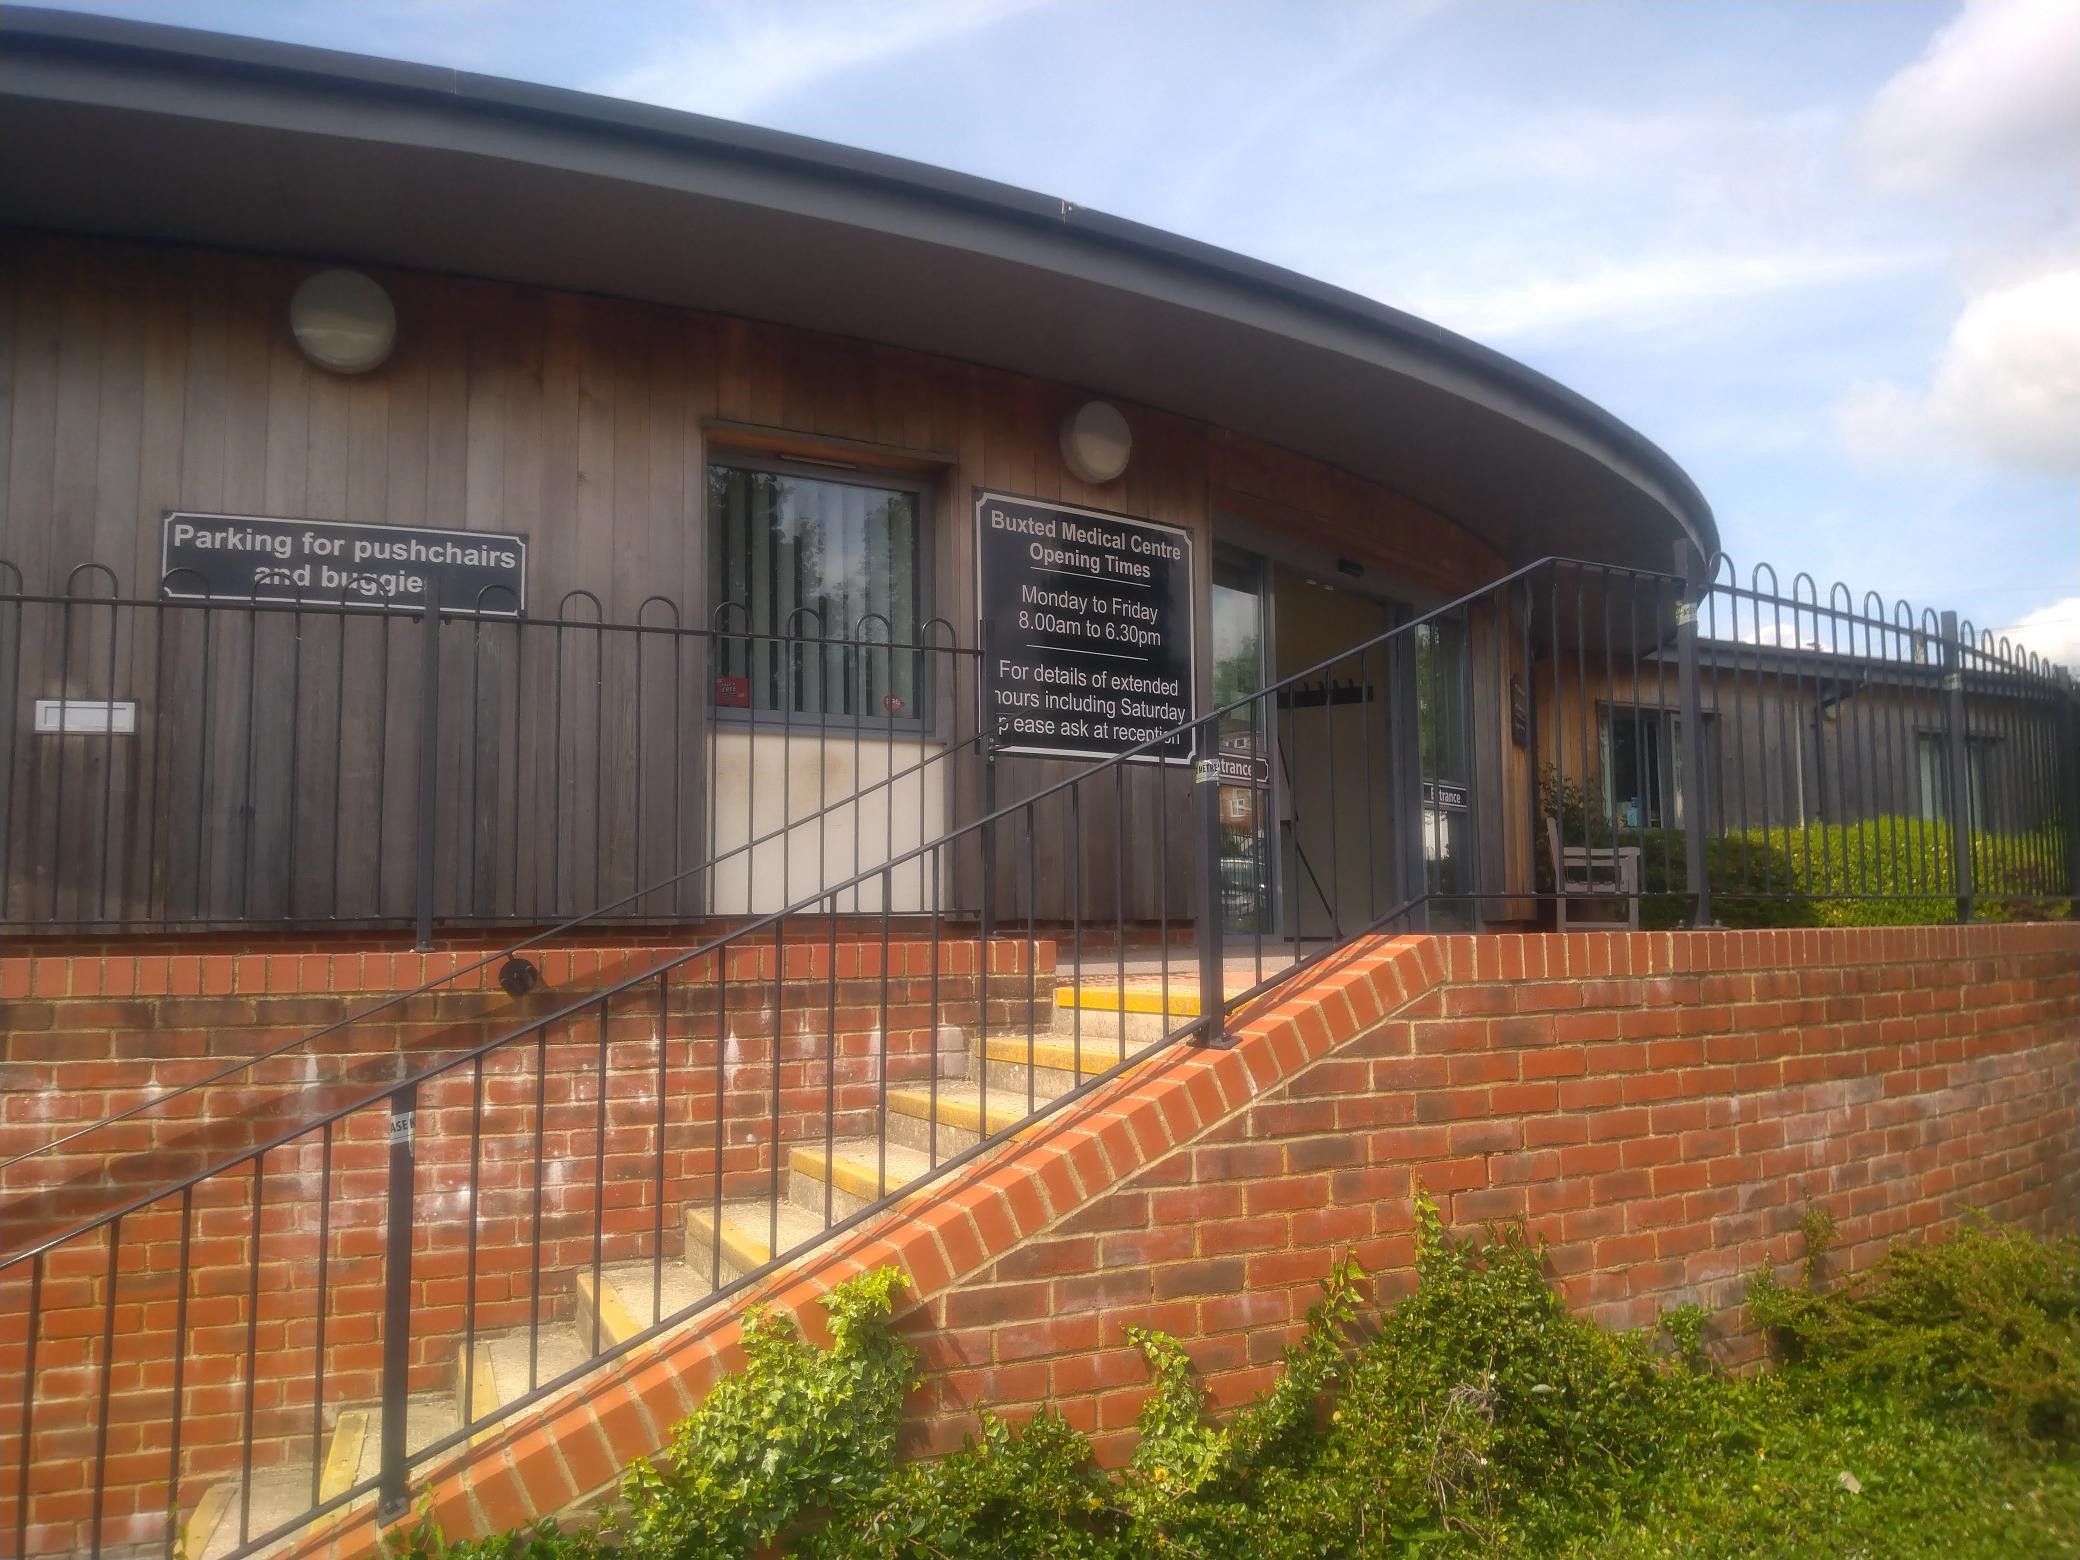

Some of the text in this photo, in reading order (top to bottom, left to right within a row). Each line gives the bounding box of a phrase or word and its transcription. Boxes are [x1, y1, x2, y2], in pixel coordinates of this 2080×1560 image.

[173, 524, 516, 569] Parking for pushchairs
[991, 509, 1182, 561] Buxted Medical Centre
[1029, 542, 1152, 578] Opening Times
[254, 564, 426, 596] and buggie
[1021, 584, 1159, 625] Monday to Friday
[1018, 610, 1162, 648] 8.00am to 6.30pm
[999, 659, 1179, 697] For details of extended
[1045, 689, 1116, 719] including
[1120, 698, 1186, 726] Saturday
[998, 715, 1055, 736] pease
[1060, 719, 1090, 738] ask
[1093, 724, 1109, 740] at
[1430, 787, 1461, 804] Etrance
